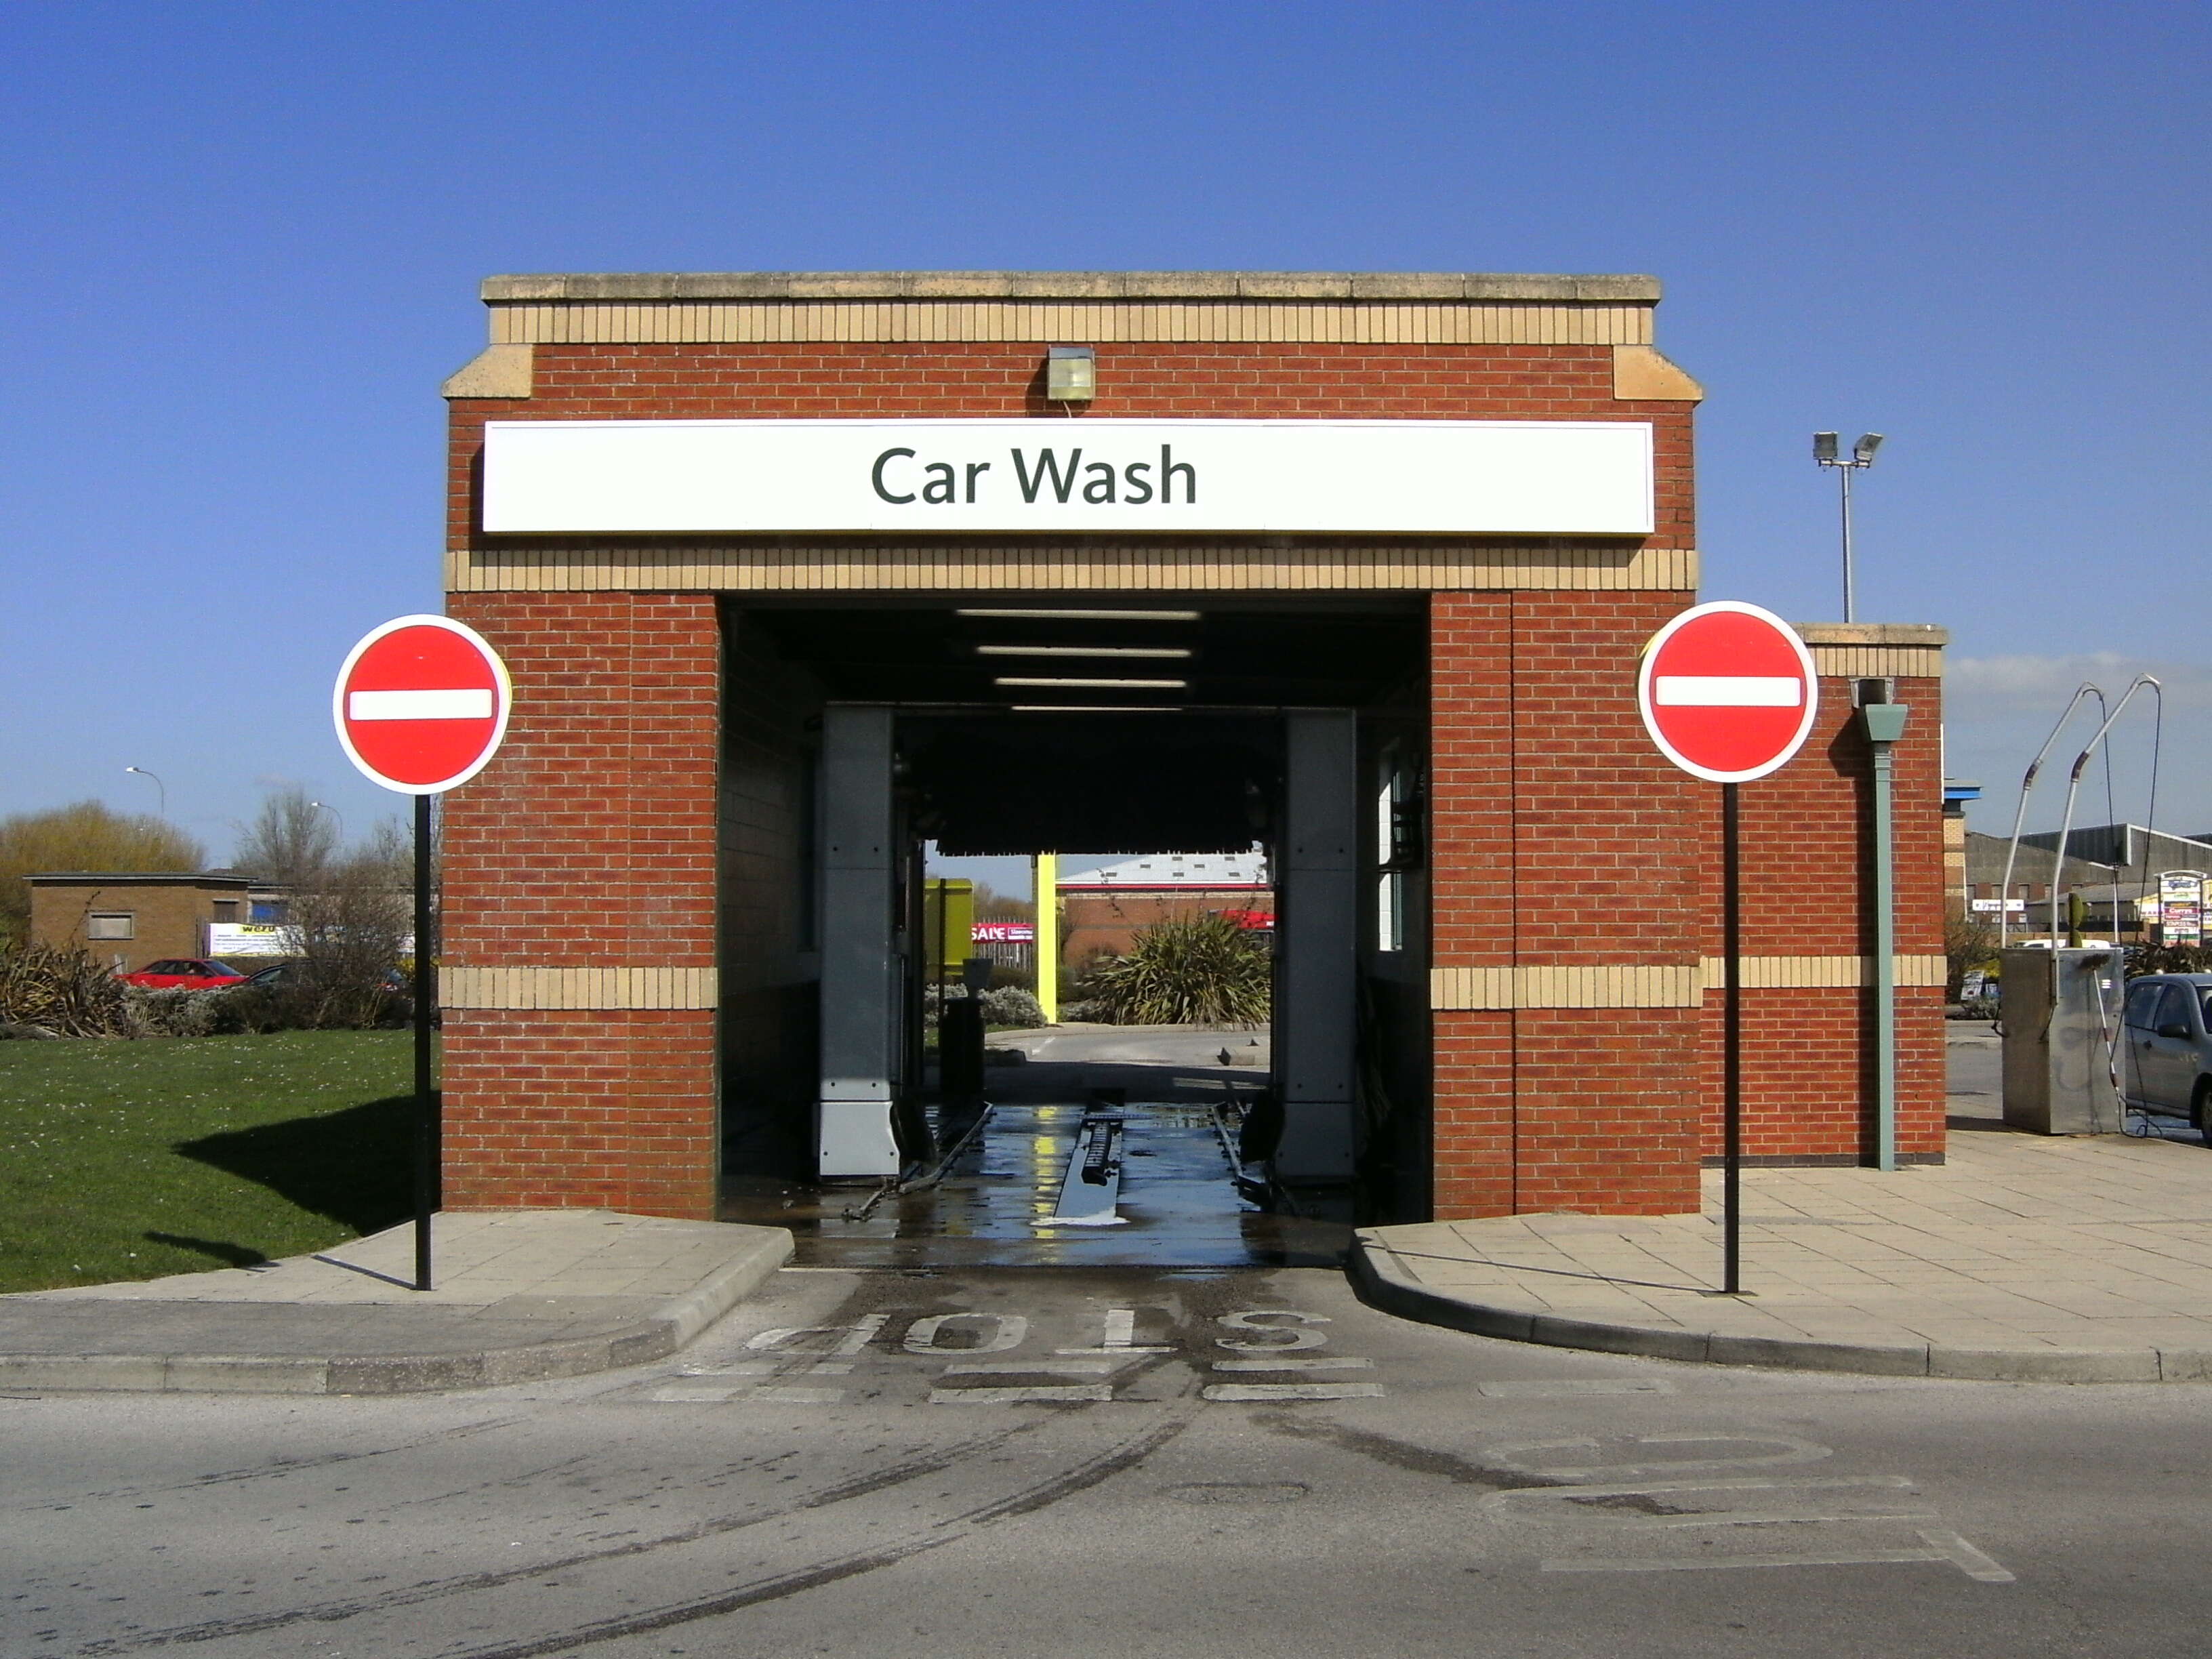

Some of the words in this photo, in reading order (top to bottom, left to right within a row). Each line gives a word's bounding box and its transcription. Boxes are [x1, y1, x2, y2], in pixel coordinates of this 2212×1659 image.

[872, 447, 991, 505] Car
[1010, 443, 1196, 505] Wash
[971, 927, 1005, 940] SALE
[744, 1308, 1334, 1355] STOP
